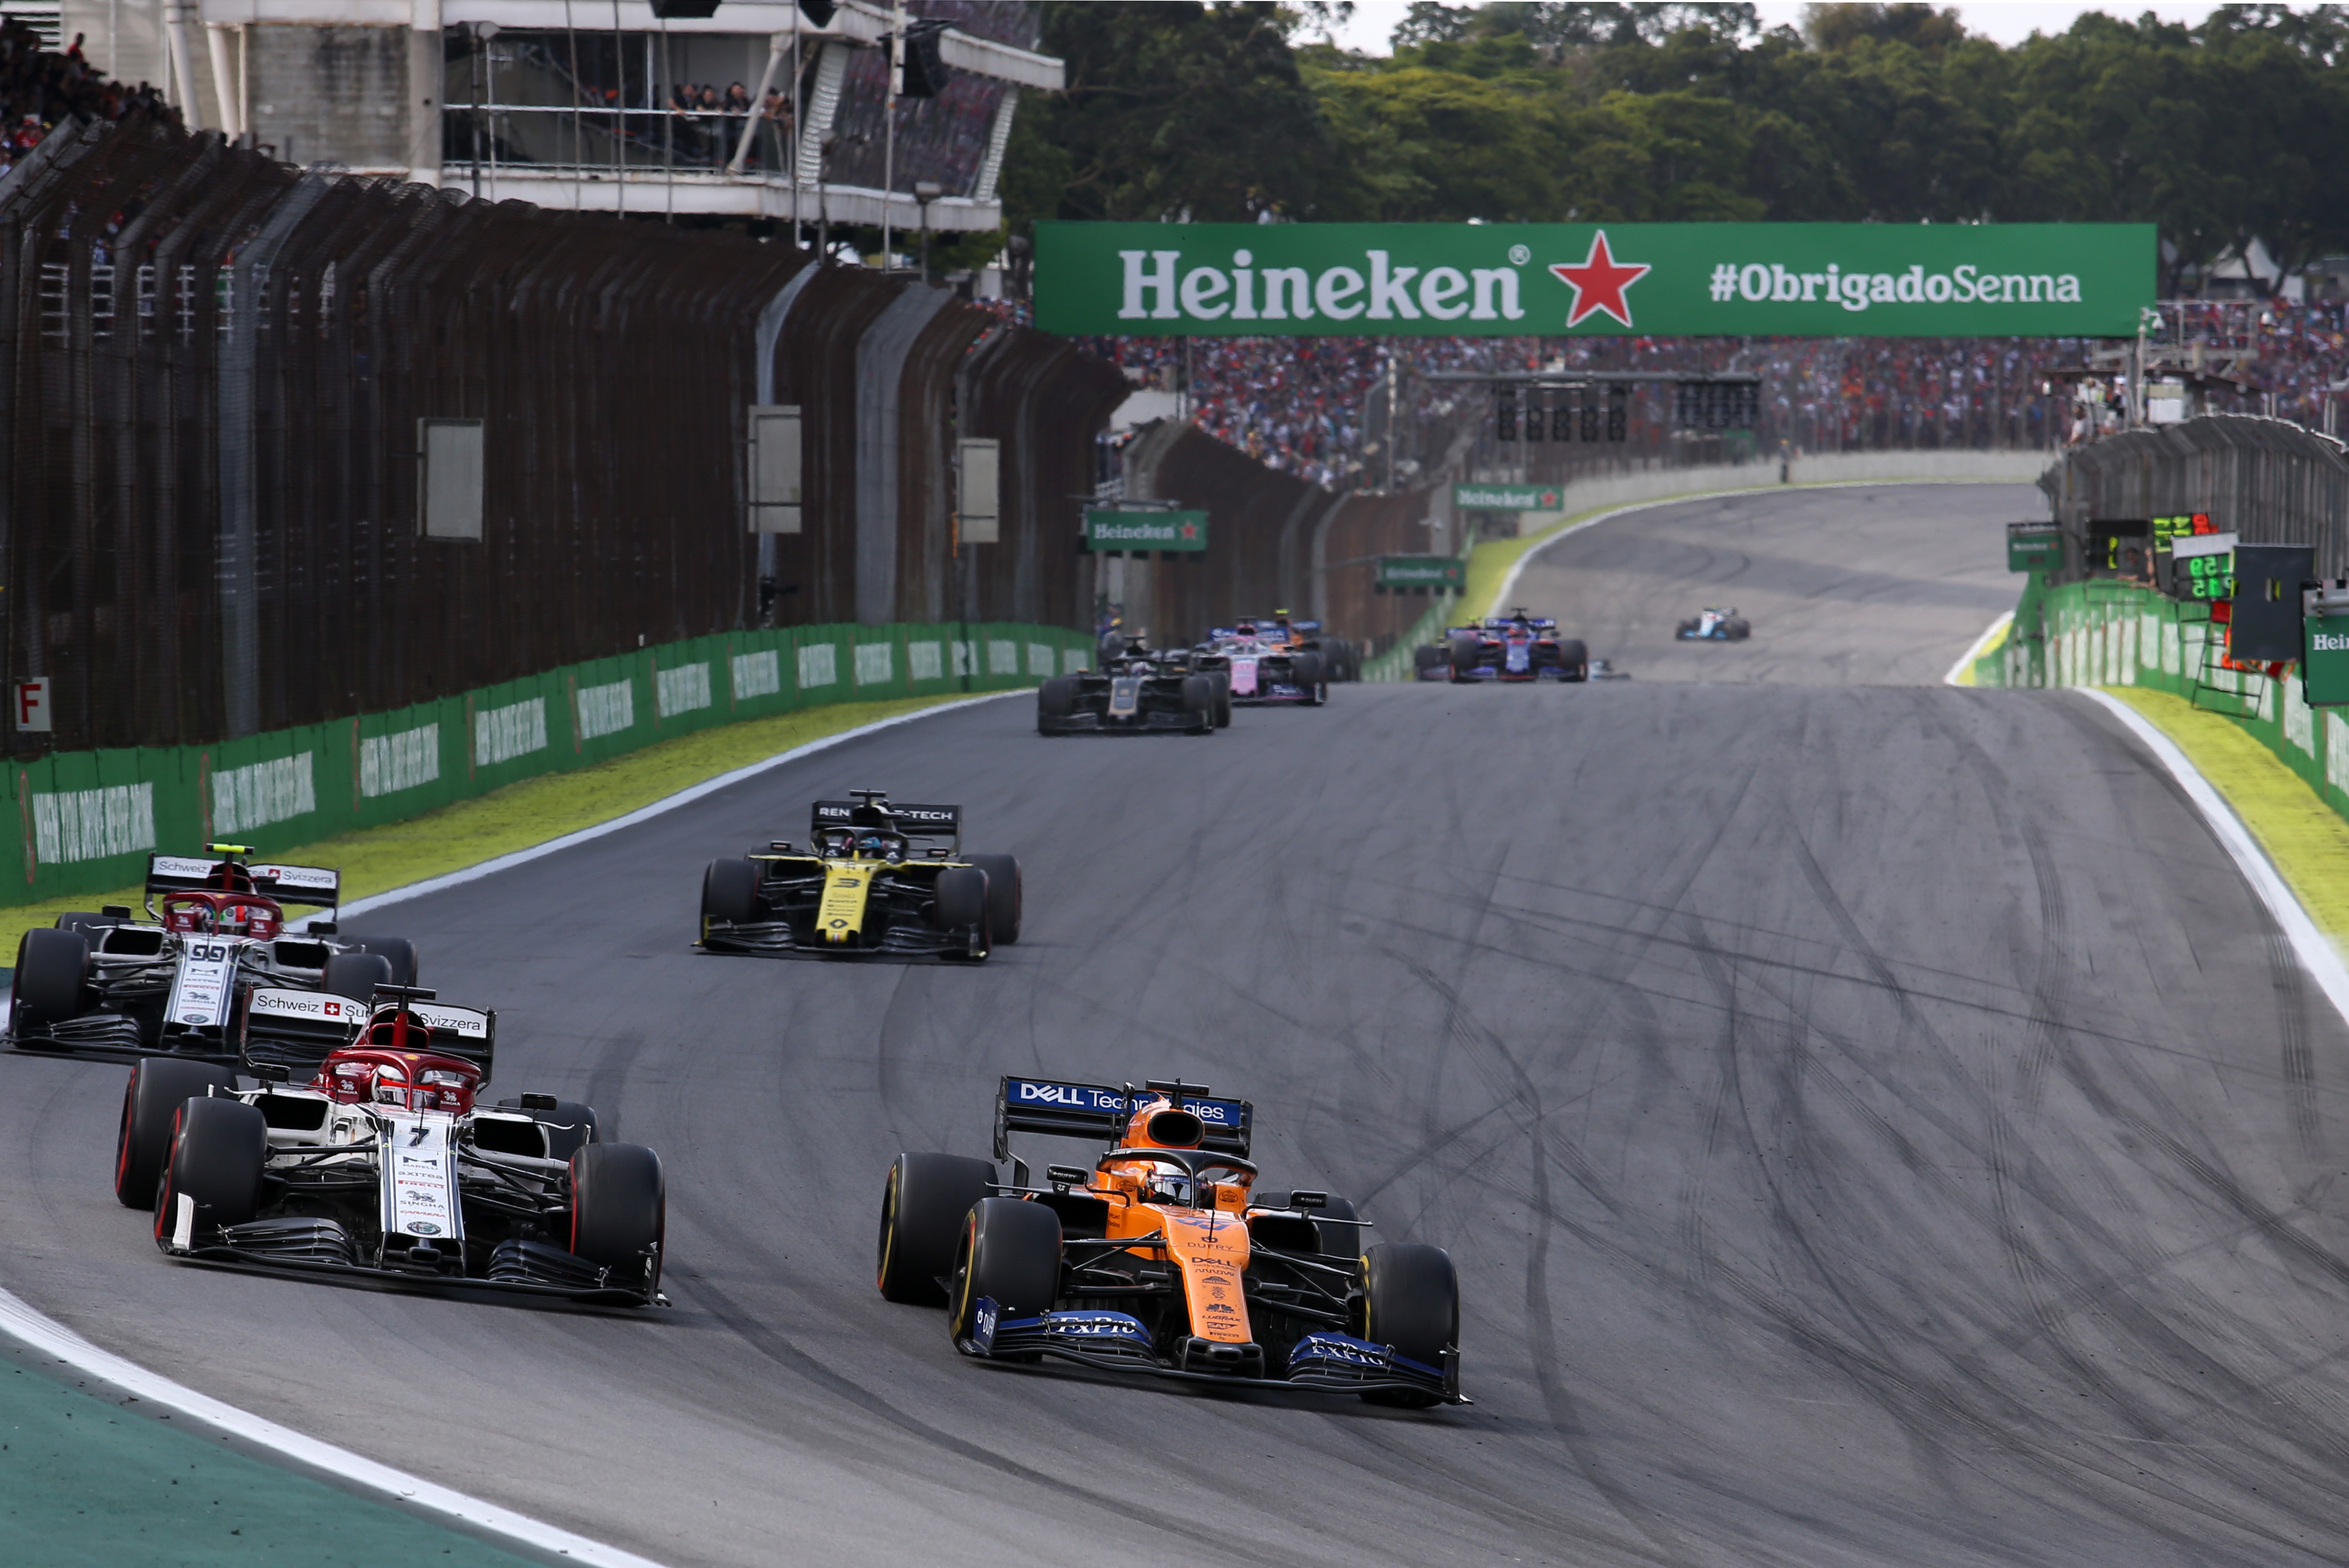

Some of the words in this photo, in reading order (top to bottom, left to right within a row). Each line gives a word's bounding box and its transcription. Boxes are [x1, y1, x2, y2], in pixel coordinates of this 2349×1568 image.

[1709, 264, 2081, 312] #ObrigadoSenna
[19, 684, 41, 724] F
[159, 861, 207, 873] Schweiz
[282, 870, 332, 883] Svizzera
[832, 878, 861, 888] 3
[190, 945, 226, 963] 99
[257, 995, 319, 1013] Schweiz
[345, 1004, 369, 1018] Sui
[420, 1012, 481, 1031] Svizzera
[1020, 1083, 1085, 1105] DELL
[1088, 1090, 1225, 1119] Tecngies
[409, 1125, 431, 1148] 7
[400, 1200, 445, 1210] SINGHA
[400, 1210, 446, 1218] CARRERA
[1187, 1242, 1233, 1250] DUFRY
[1191, 1257, 1236, 1269] DELL
[1056, 1316, 1137, 1334] FxPro
[1307, 1335, 1384, 1366] FxPro
